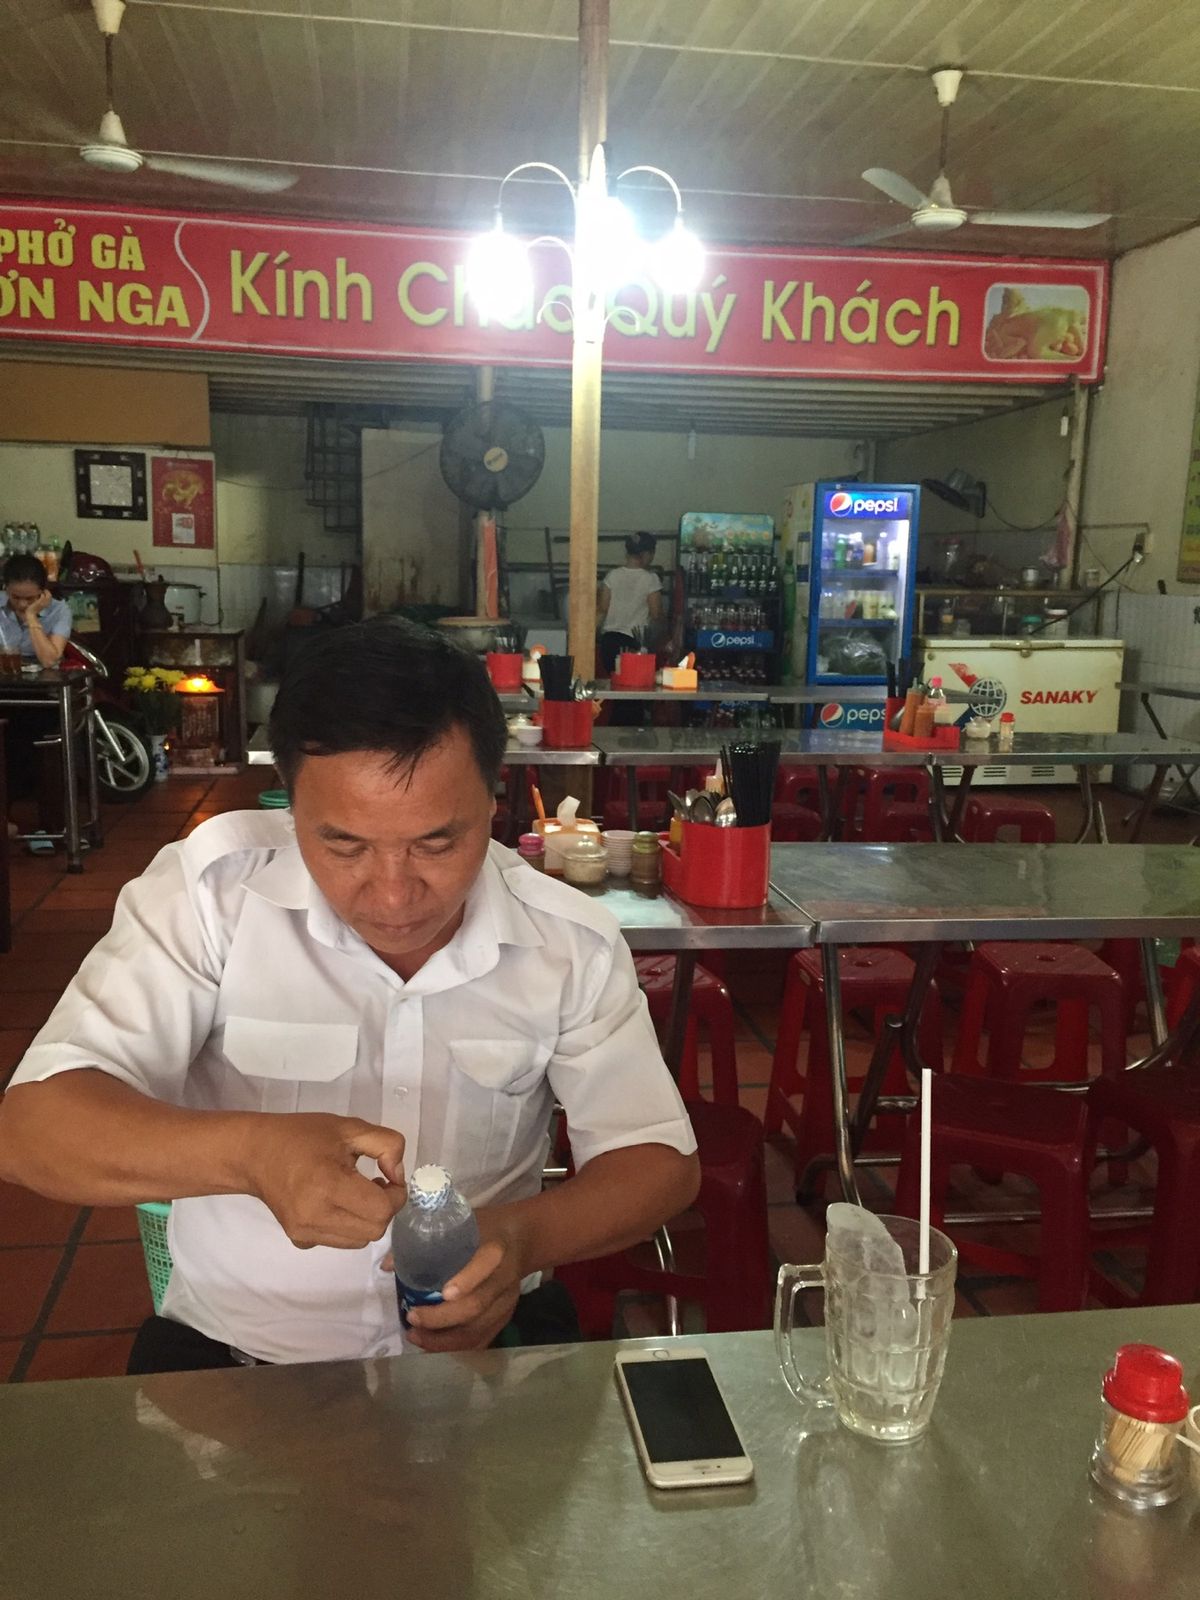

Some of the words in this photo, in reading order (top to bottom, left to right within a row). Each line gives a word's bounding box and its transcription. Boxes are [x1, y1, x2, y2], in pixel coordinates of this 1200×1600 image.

[0, 218, 76, 267] PHỞ
[91, 225, 145, 271] GÀ
[78, 280, 190, 327] NGA
[230, 250, 373, 322] Kính
[398, 261, 575, 332] Cho
[604, 275, 736, 352] Quý
[762, 279, 960, 346] Khách
[853, 497, 898, 515] pepsi
[726, 635, 755, 646] pepsi
[1020, 690, 1098, 704] SANAKY
[847, 708, 887, 724] peps
